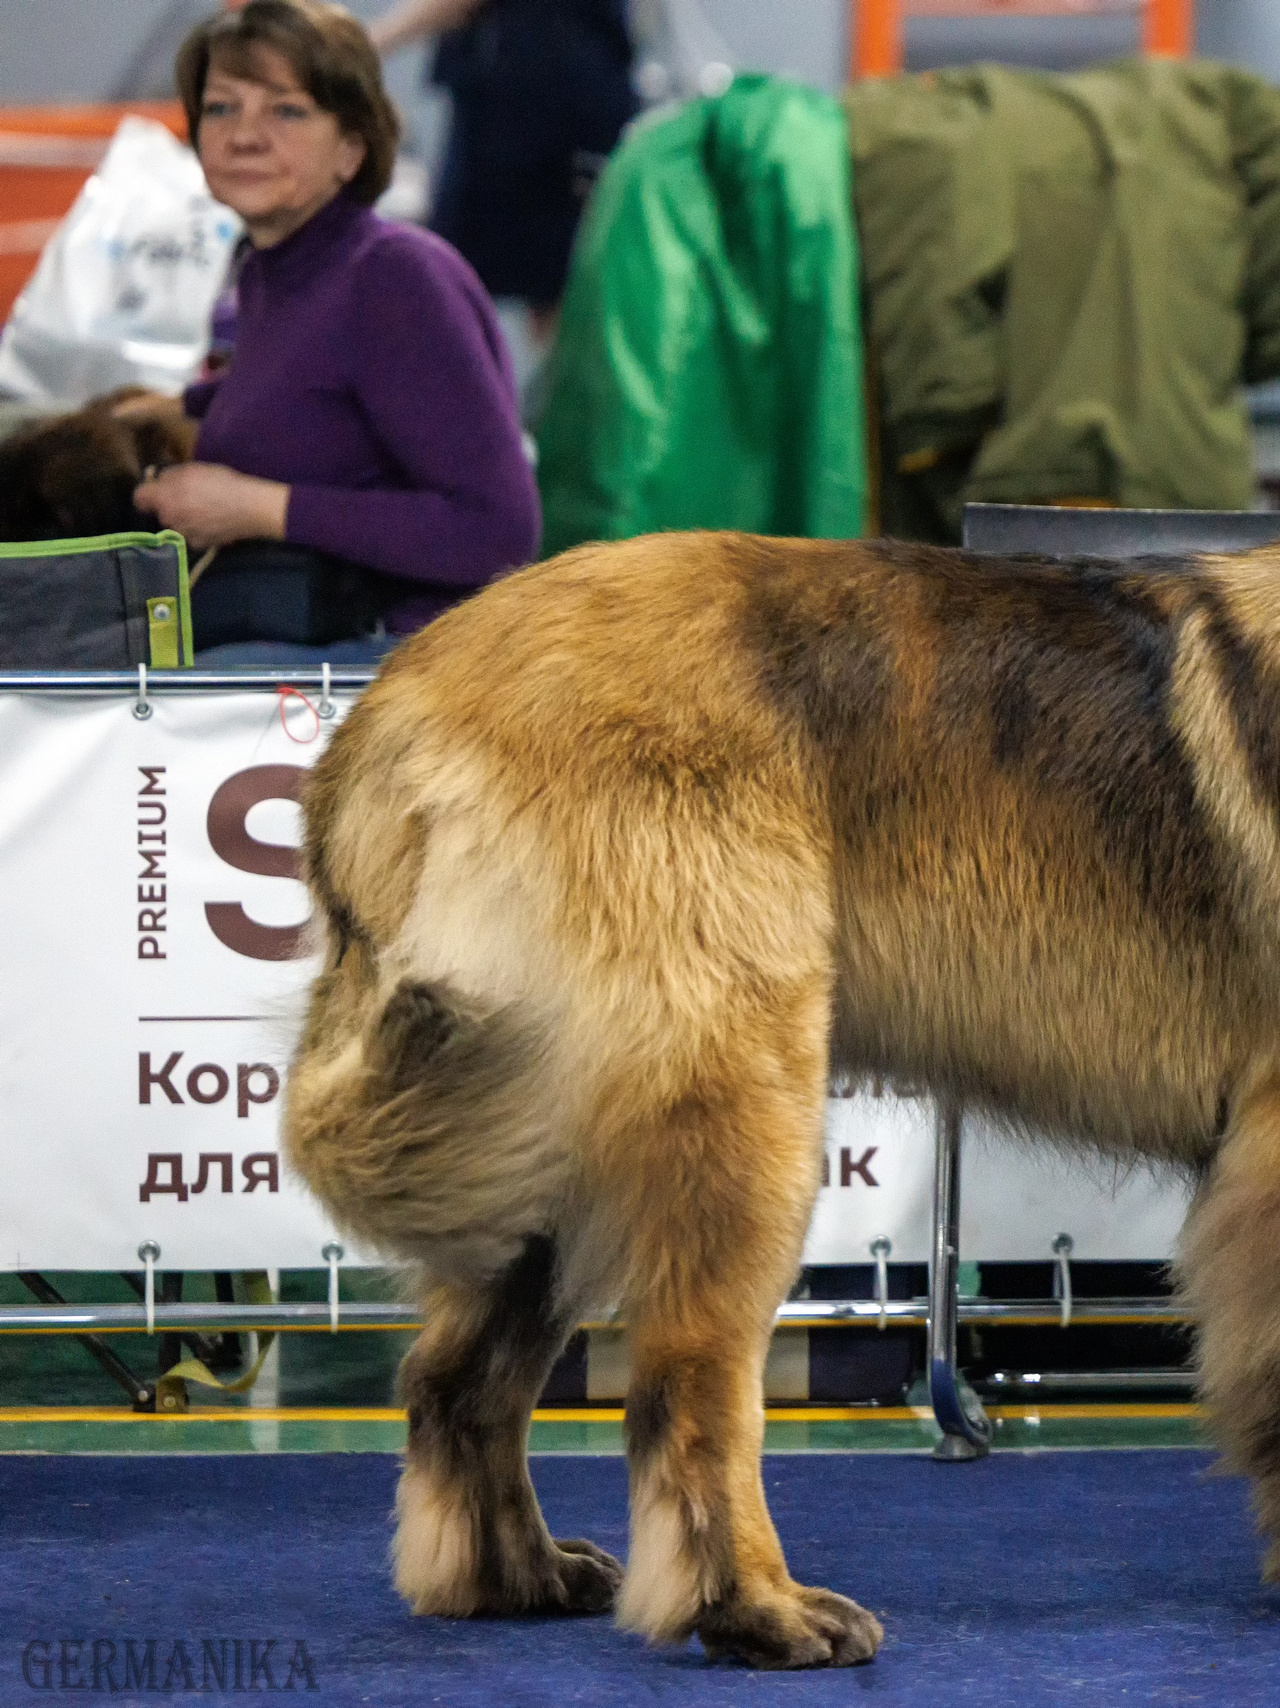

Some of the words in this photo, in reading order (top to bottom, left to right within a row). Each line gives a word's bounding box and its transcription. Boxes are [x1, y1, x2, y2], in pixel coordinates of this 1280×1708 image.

[137, 765, 167, 960] PREMIUM
[138, 1051, 280, 1118] Кор
[138, 1152, 280, 1202] для
